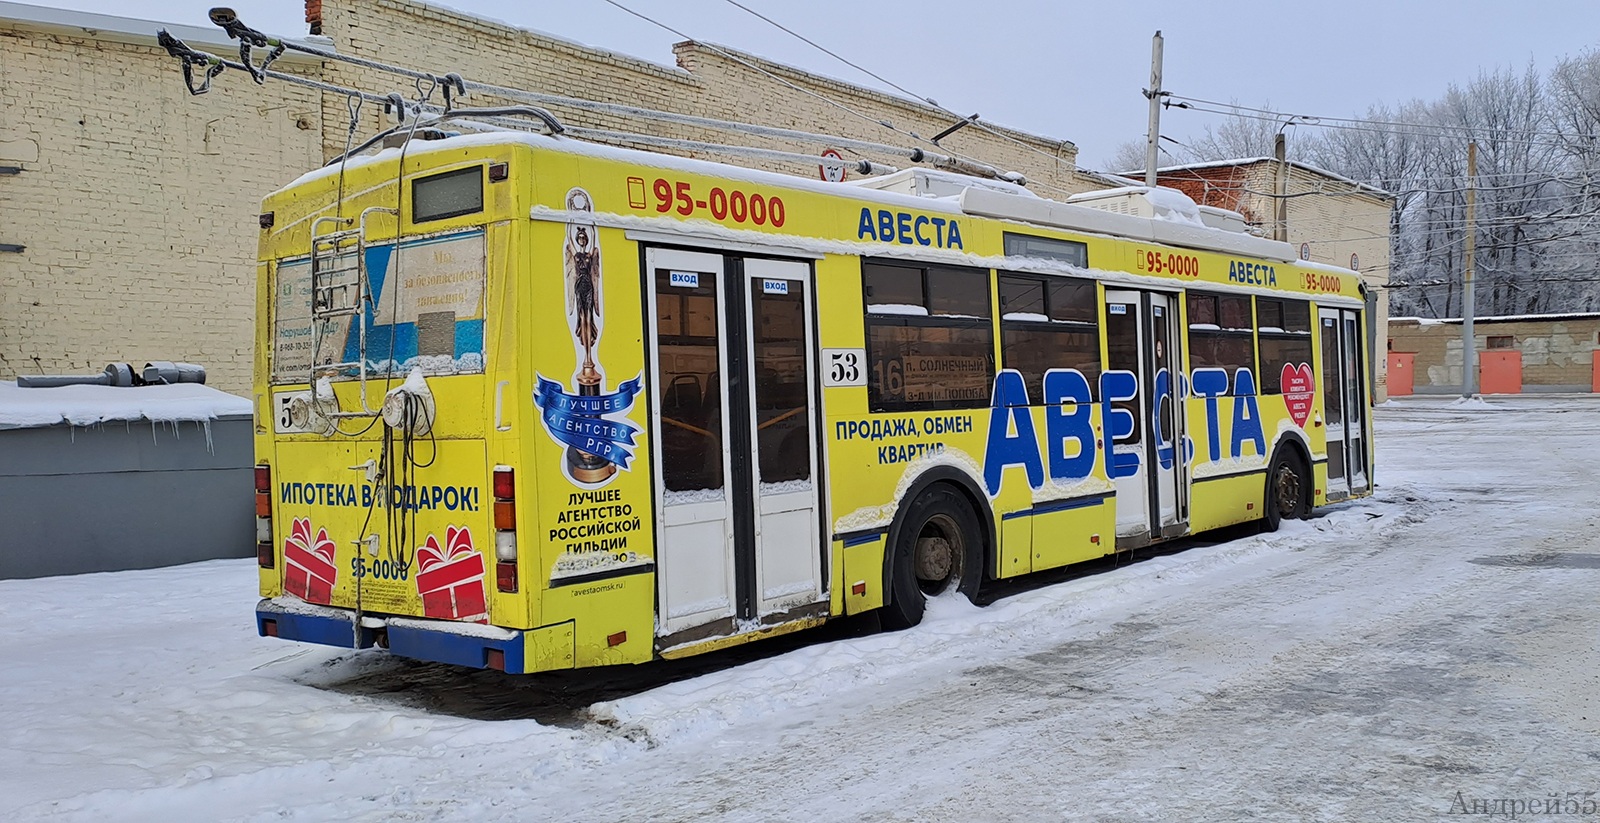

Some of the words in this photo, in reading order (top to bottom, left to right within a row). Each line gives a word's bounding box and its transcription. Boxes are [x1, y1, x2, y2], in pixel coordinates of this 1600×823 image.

[653, 178, 785, 228] 95-0000
[858, 207, 963, 250] АВЕСТА
[1147, 252, 1199, 277] 95-0000
[1229, 261, 1277, 287] АВЕСТА
[416, 270, 481, 288] безопасность
[672, 273, 697, 285] ВХОД
[764, 281, 787, 292] ВХОД
[1306, 273, 1341, 293] 95-0000
[831, 353, 859, 382] 53
[919, 358, 984, 372] СОЛНЕЧНЫЙ
[873, 359, 903, 396] 16
[558, 397, 621, 410] ЛУЧШЕЕ
[548, 413, 628, 440] АГЕНТСТВО
[836, 418, 920, 441] ПРОДАЖА,
[924, 416, 973, 436] ОБМЕН
[983, 368, 1266, 498] АВЕСТА
[586, 438, 612, 456] РГР
[281, 482, 357, 507] ИПОТЕКА
[362, 484, 372, 508] В
[377, 485, 479, 514] ПОДАРОК!
[568, 489, 621, 506] ЛУЧШЕЕ
[557, 504, 632, 524] АГЕНТСТВО
[549, 518, 641, 542] РОССИЙСКОЙ
[566, 536, 627, 555] ГИЛЬДИИ
[351, 557, 408, 581] 95-0000
[574, 582, 623, 597] avestaomsk.ru
